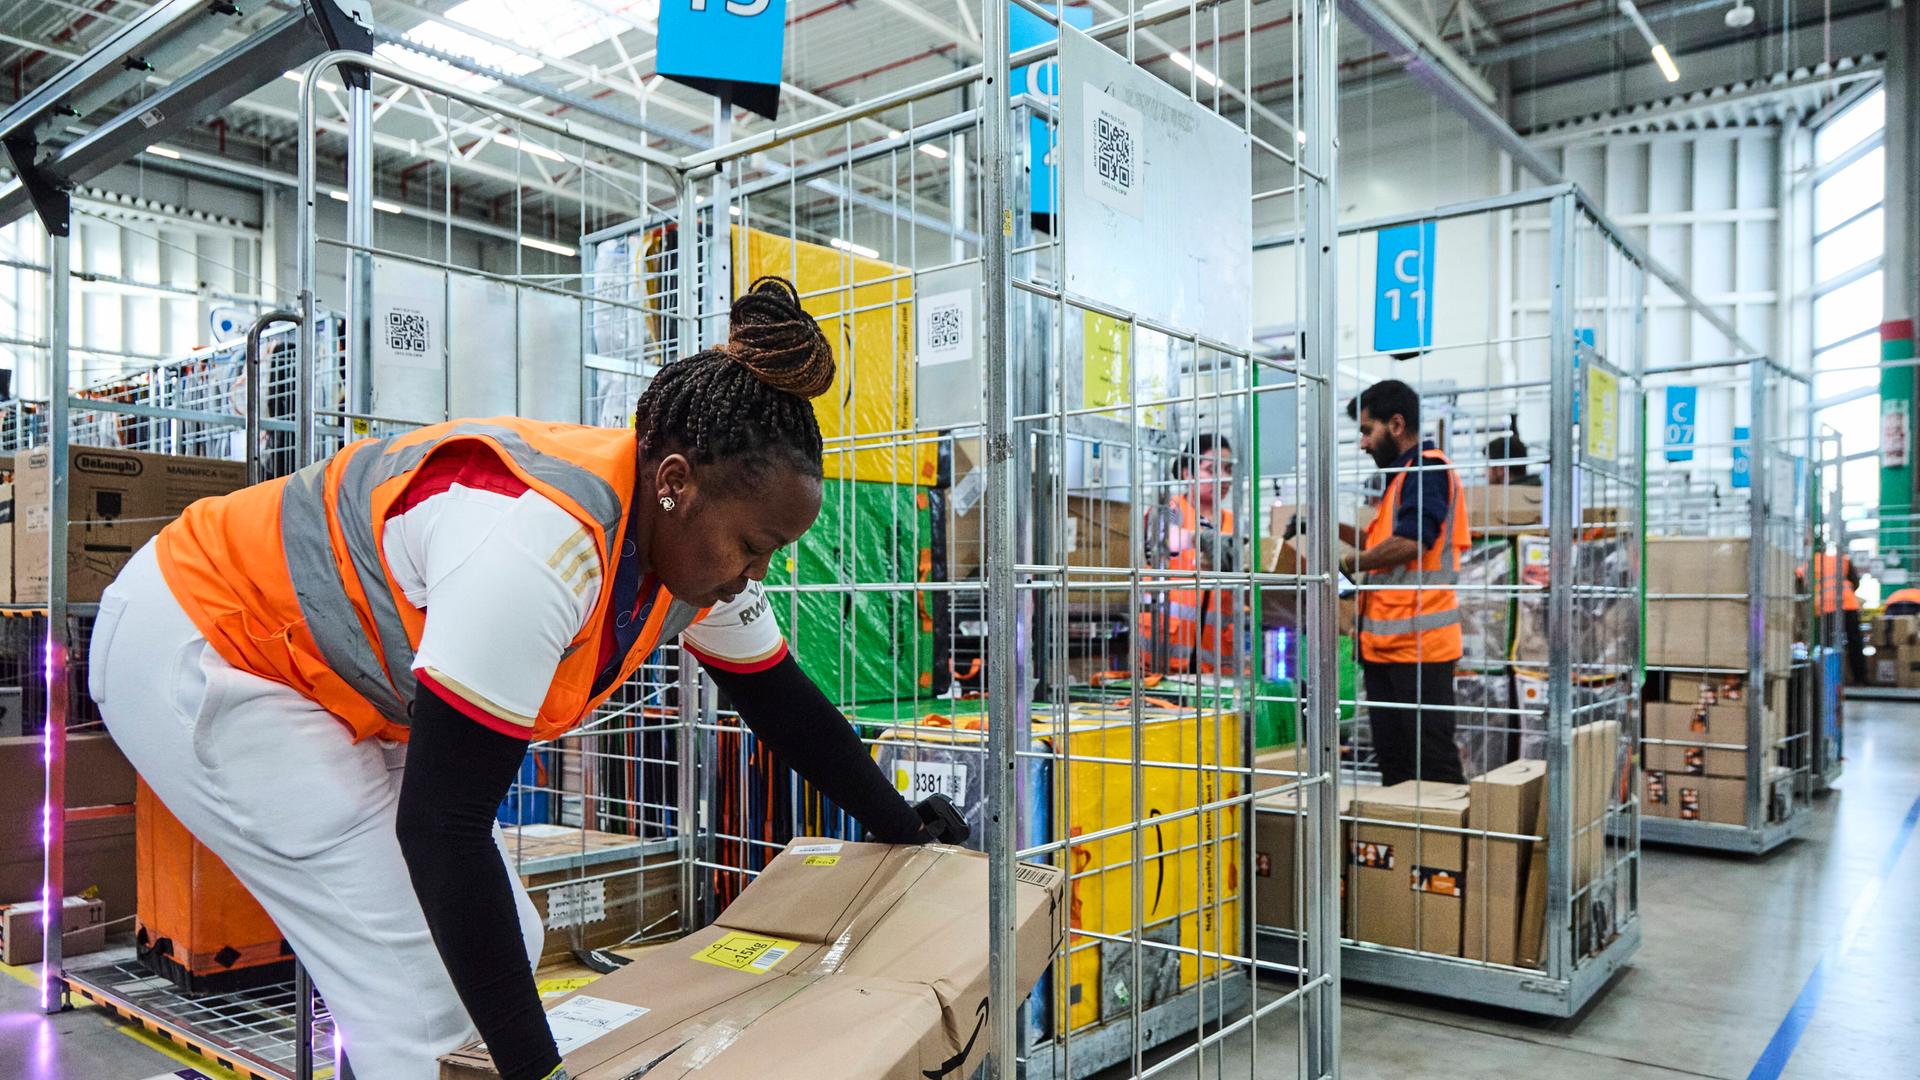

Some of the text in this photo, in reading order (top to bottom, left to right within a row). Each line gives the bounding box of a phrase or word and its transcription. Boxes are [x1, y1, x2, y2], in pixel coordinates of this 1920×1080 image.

[1394, 249, 1421, 284] C
[1383, 288, 1427, 322] 11
[1672, 401, 1688, 423] C
[1664, 424, 1694, 444] 07
[82, 456, 137, 472] DeLonghi
[739, 592, 768, 626] RW
